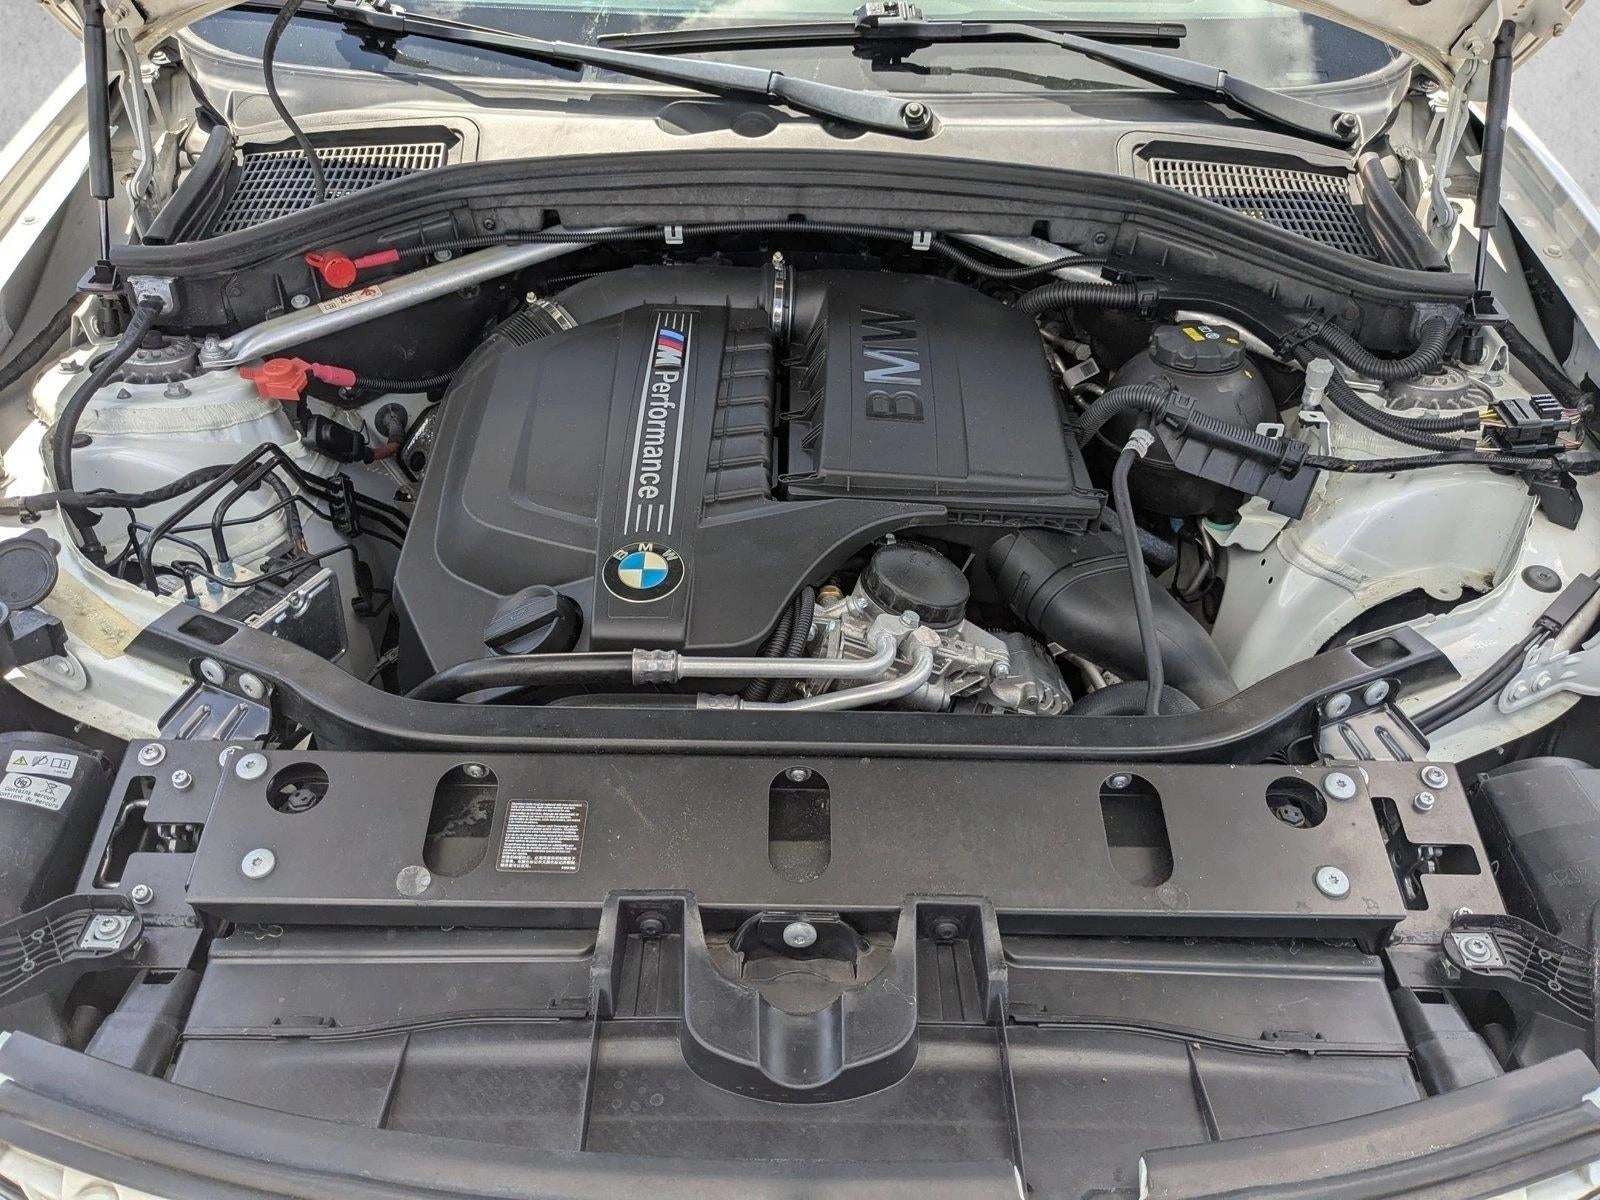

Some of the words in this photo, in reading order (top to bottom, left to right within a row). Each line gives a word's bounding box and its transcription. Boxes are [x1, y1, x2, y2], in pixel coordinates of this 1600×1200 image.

[655, 344, 683, 367] M
[860, 304, 925, 424] BMW
[638, 371, 680, 499] Performance
[613, 543, 679, 561] BMW
[0, 790, 23, 800] ontient
[35, 798, 59, 809] mercure
[4, 785, 31, 796] Contains
[33, 791, 57, 803] mercury
